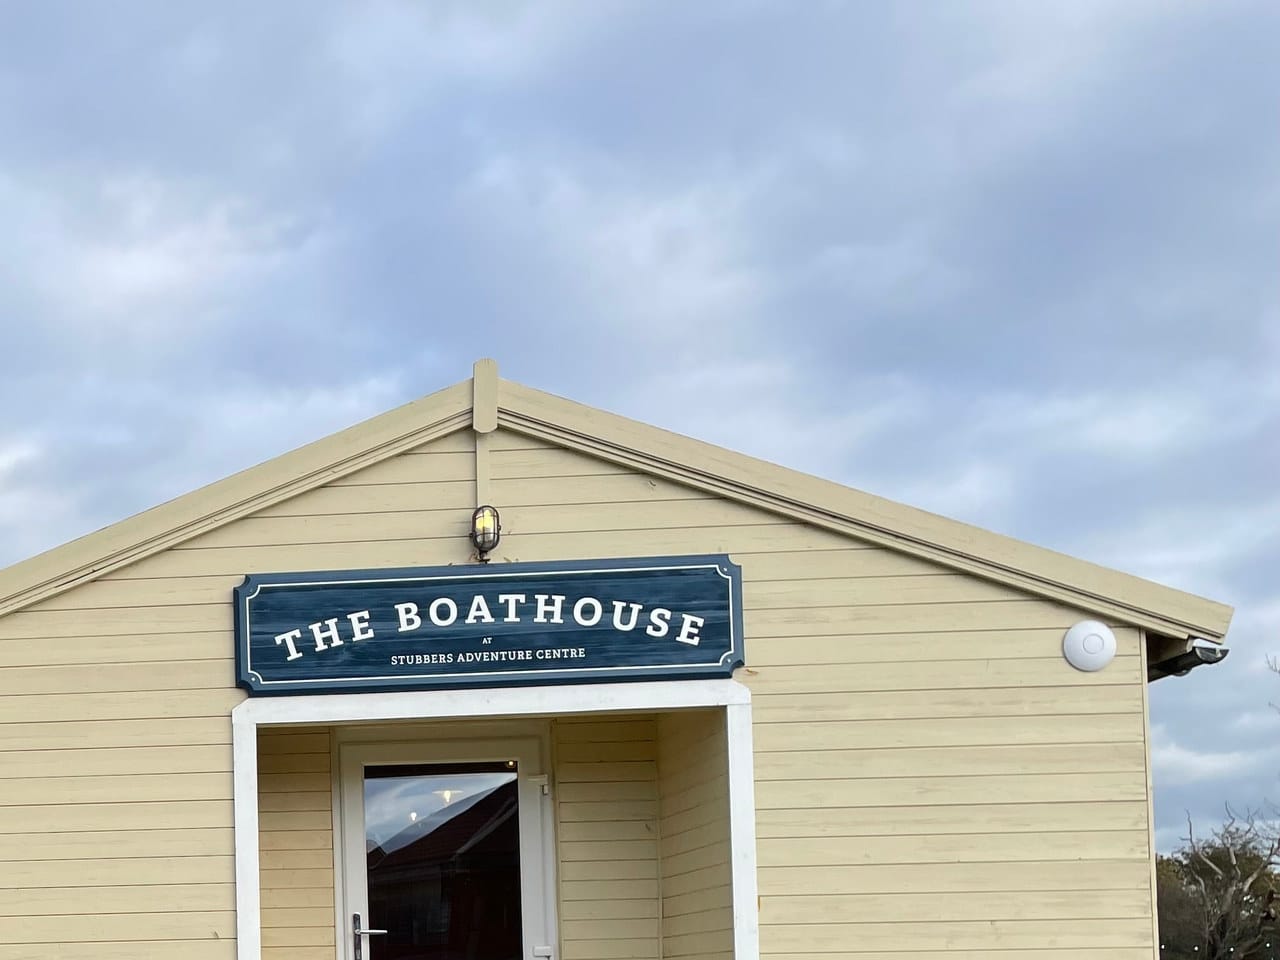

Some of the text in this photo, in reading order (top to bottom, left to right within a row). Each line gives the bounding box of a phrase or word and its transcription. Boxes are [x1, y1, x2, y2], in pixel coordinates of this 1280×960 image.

[274, 593, 705, 662] THE BOATHOUSE
[482, 637, 493, 645] AT
[391, 647, 586, 666] STUBBERS ADVENTURE CENTRE
